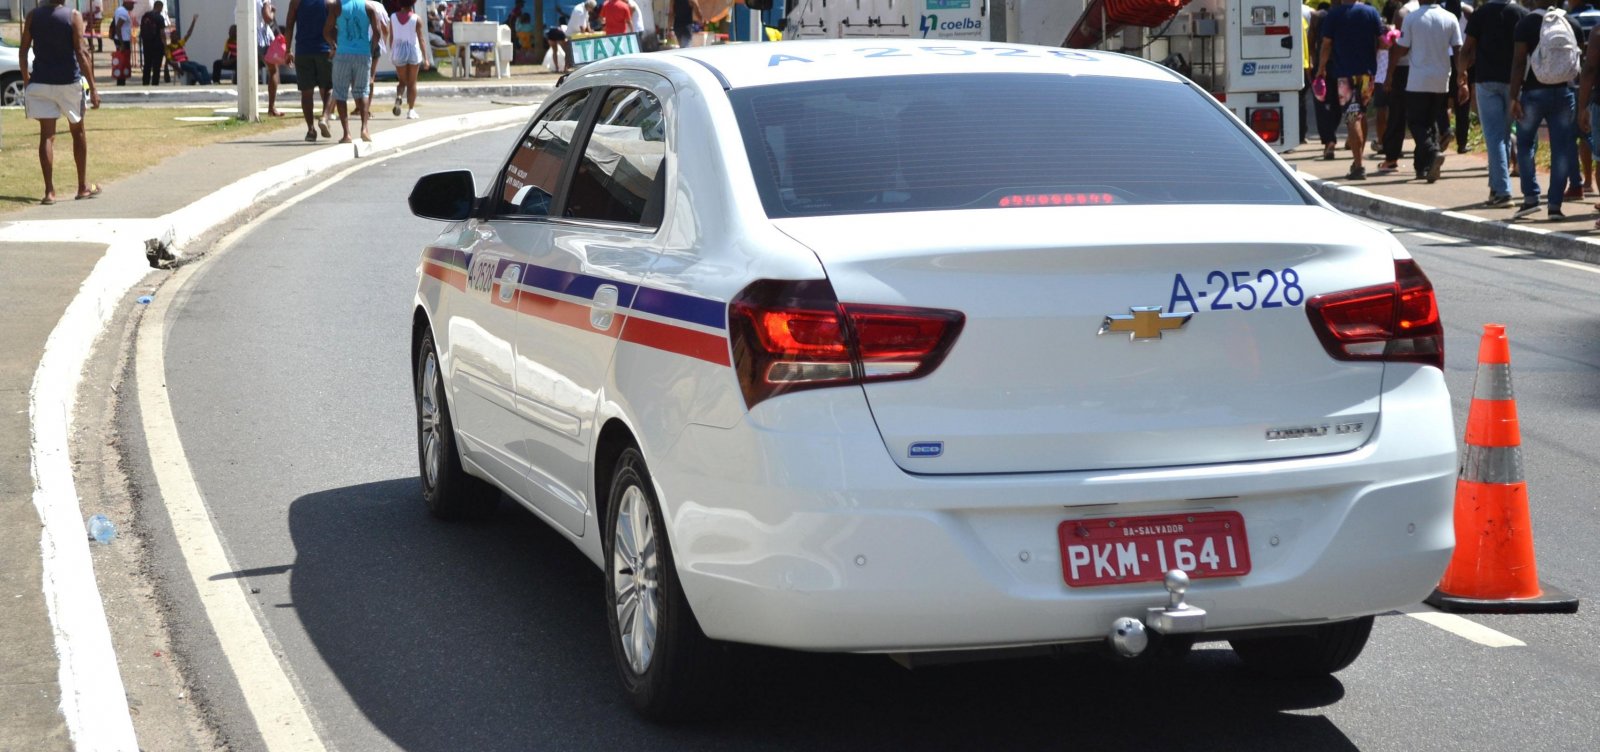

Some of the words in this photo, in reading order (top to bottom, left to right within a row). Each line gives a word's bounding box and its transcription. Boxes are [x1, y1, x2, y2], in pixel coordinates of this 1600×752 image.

[940, 17, 982, 30] coelba
[575, 34, 633, 61] TAXI
[467, 260, 496, 293] A-2528
[1168, 267, 1305, 314] A-2528
[1265, 426, 1330, 442] COBALT
[911, 445, 940, 454] eco
[1123, 524, 1184, 537] BA-SALVADOR
